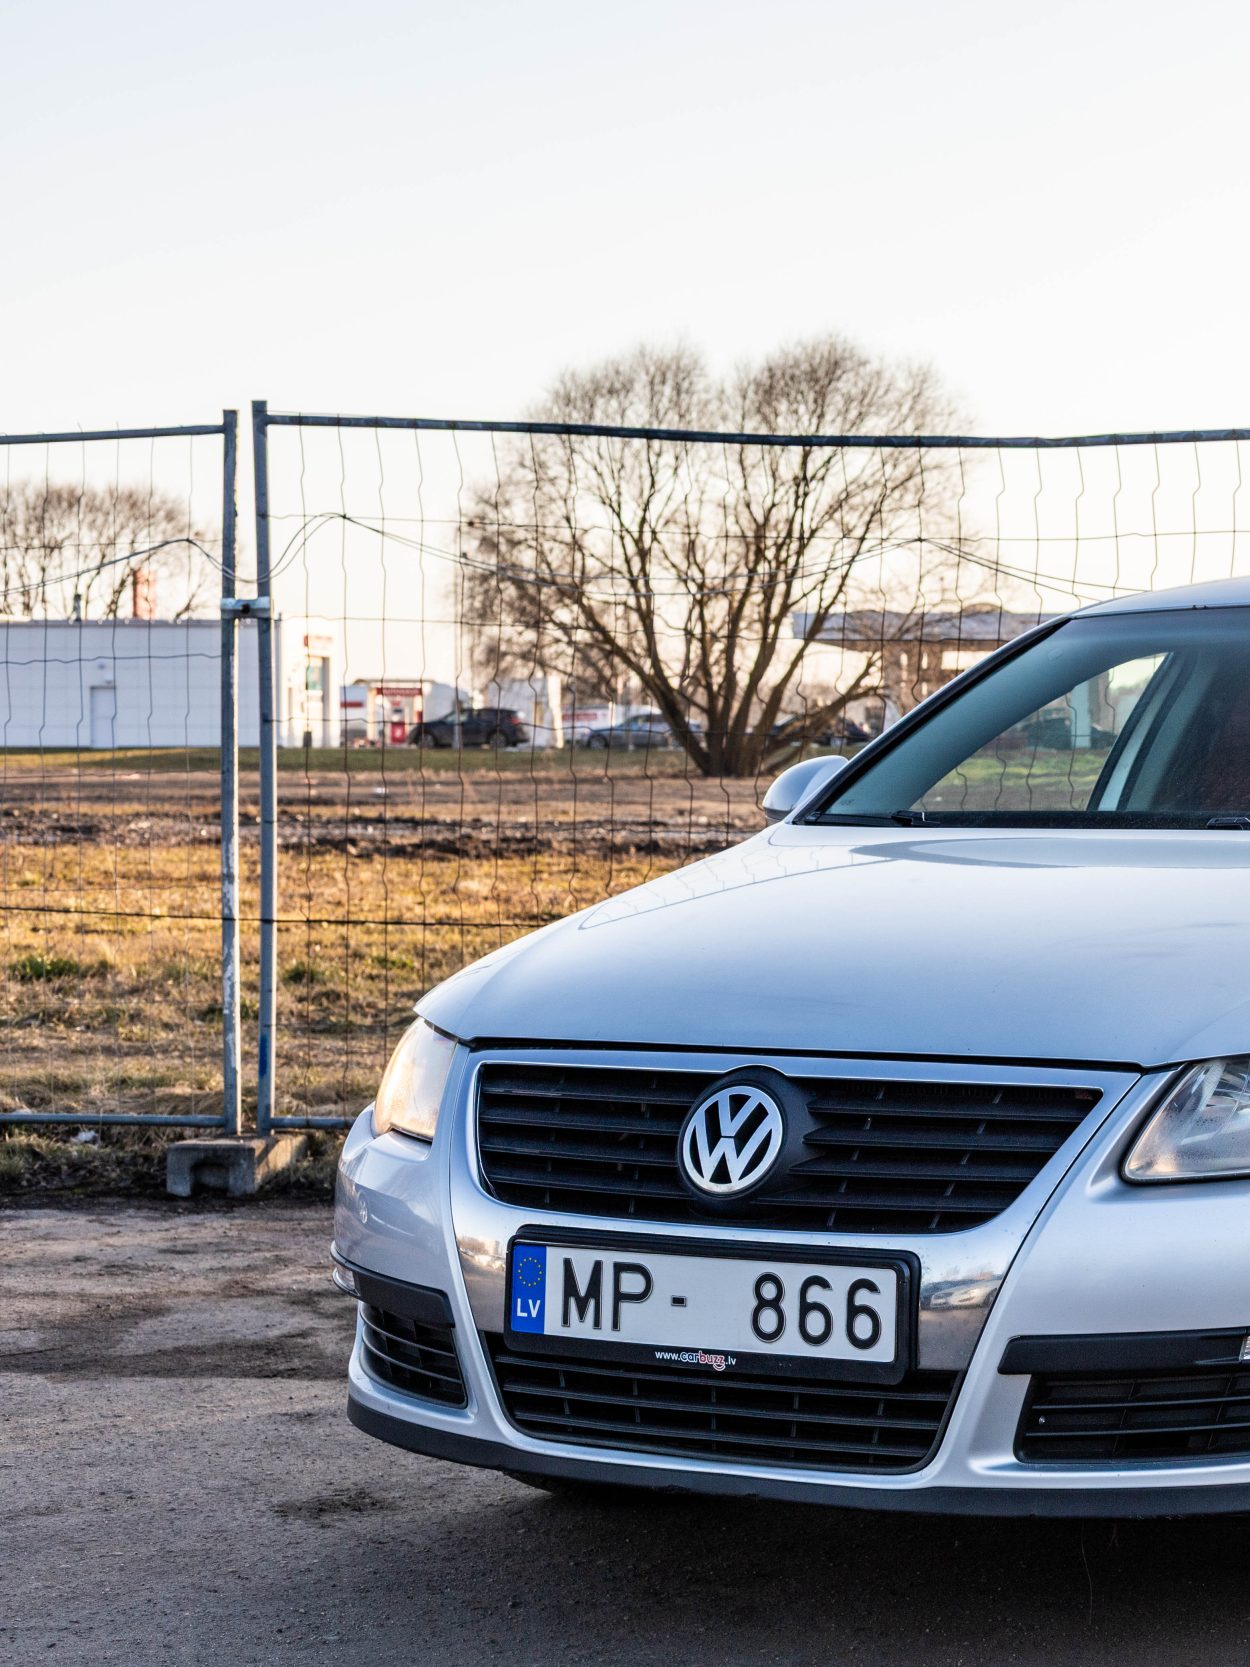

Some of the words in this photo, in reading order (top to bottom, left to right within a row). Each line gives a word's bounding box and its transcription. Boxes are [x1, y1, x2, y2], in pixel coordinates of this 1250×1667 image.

[683, 1086, 782, 1192] VW
[516, 1297, 541, 1318] LV
[750, 1271, 882, 1350] 866
[654, 1350, 737, 1368] www.carbuzz.lv
